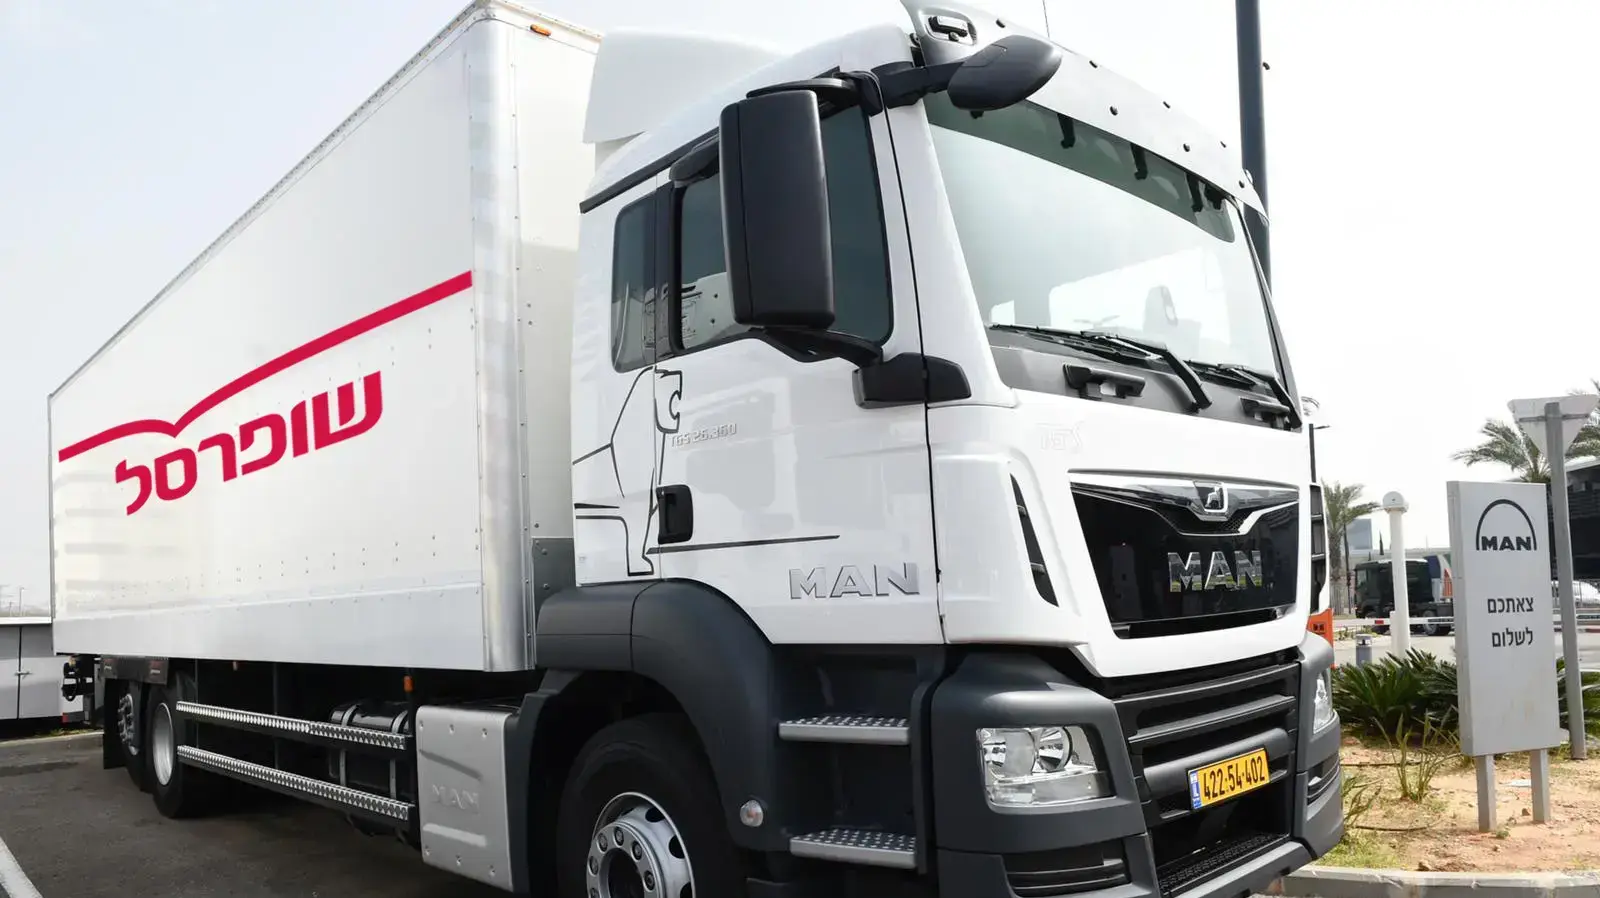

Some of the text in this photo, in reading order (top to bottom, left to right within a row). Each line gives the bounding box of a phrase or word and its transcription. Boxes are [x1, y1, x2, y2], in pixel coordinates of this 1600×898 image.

[115, 371, 383, 515] שופרסל
[1481, 536, 1531, 551] MAN
[789, 562, 920, 599] MAN
[1167, 550, 1263, 593] MAN
[1487, 597, 1534, 614] צאתכם
[1491, 627, 1533, 647] לשלום
